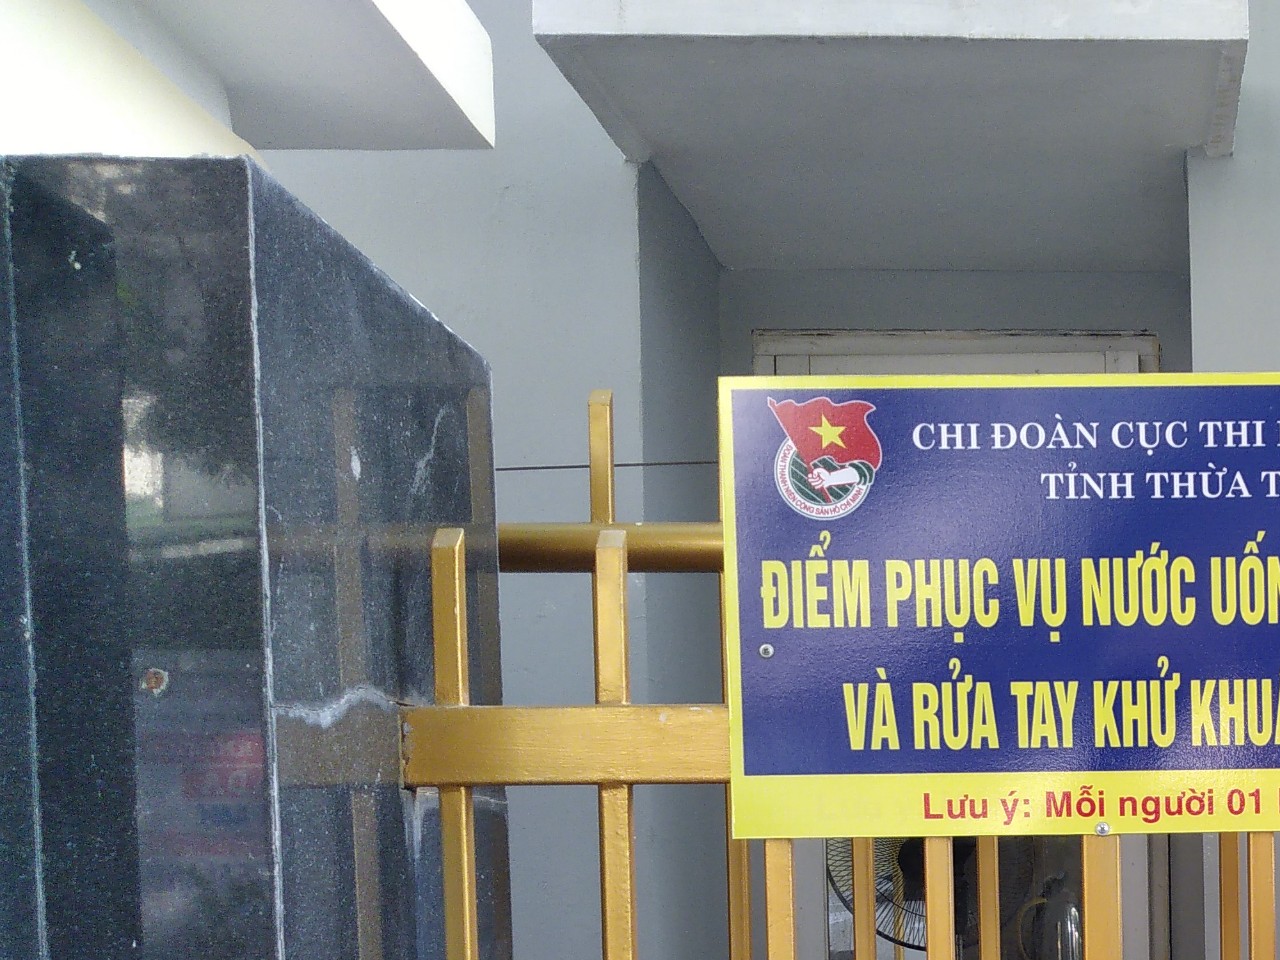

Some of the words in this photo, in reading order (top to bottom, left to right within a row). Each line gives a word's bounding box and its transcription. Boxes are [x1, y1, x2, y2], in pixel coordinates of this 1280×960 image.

[912, 423, 981, 450] CHI
[991, 413, 1100, 449] ĐOÀN
[1111, 421, 1189, 456] CỤC
[1199, 420, 1266, 447] THI
[779, 463, 788, 488] THANH
[850, 487, 864, 503] MINH
[1040, 461, 1136, 500] TỈNH
[1146, 462, 1253, 499] THỪA
[760, 530, 872, 629] ĐIỂM
[885, 557, 1000, 643] PHỤC
[1013, 558, 1067, 643] VỤ
[1082, 542, 1196, 627] NƯỚC
[842, 668, 900, 751] VÀ
[912, 657, 1000, 751] RỬA
[1010, 681, 1079, 750] TAY
[1093, 656, 1181, 748] KHỬ
[922, 793, 988, 819] Lưu
[999, 791, 1032, 825] ý:
[1046, 784, 1105, 818] Mỗi
[1118, 788, 1215, 824] người
[1226, 789, 1262, 815] 01
